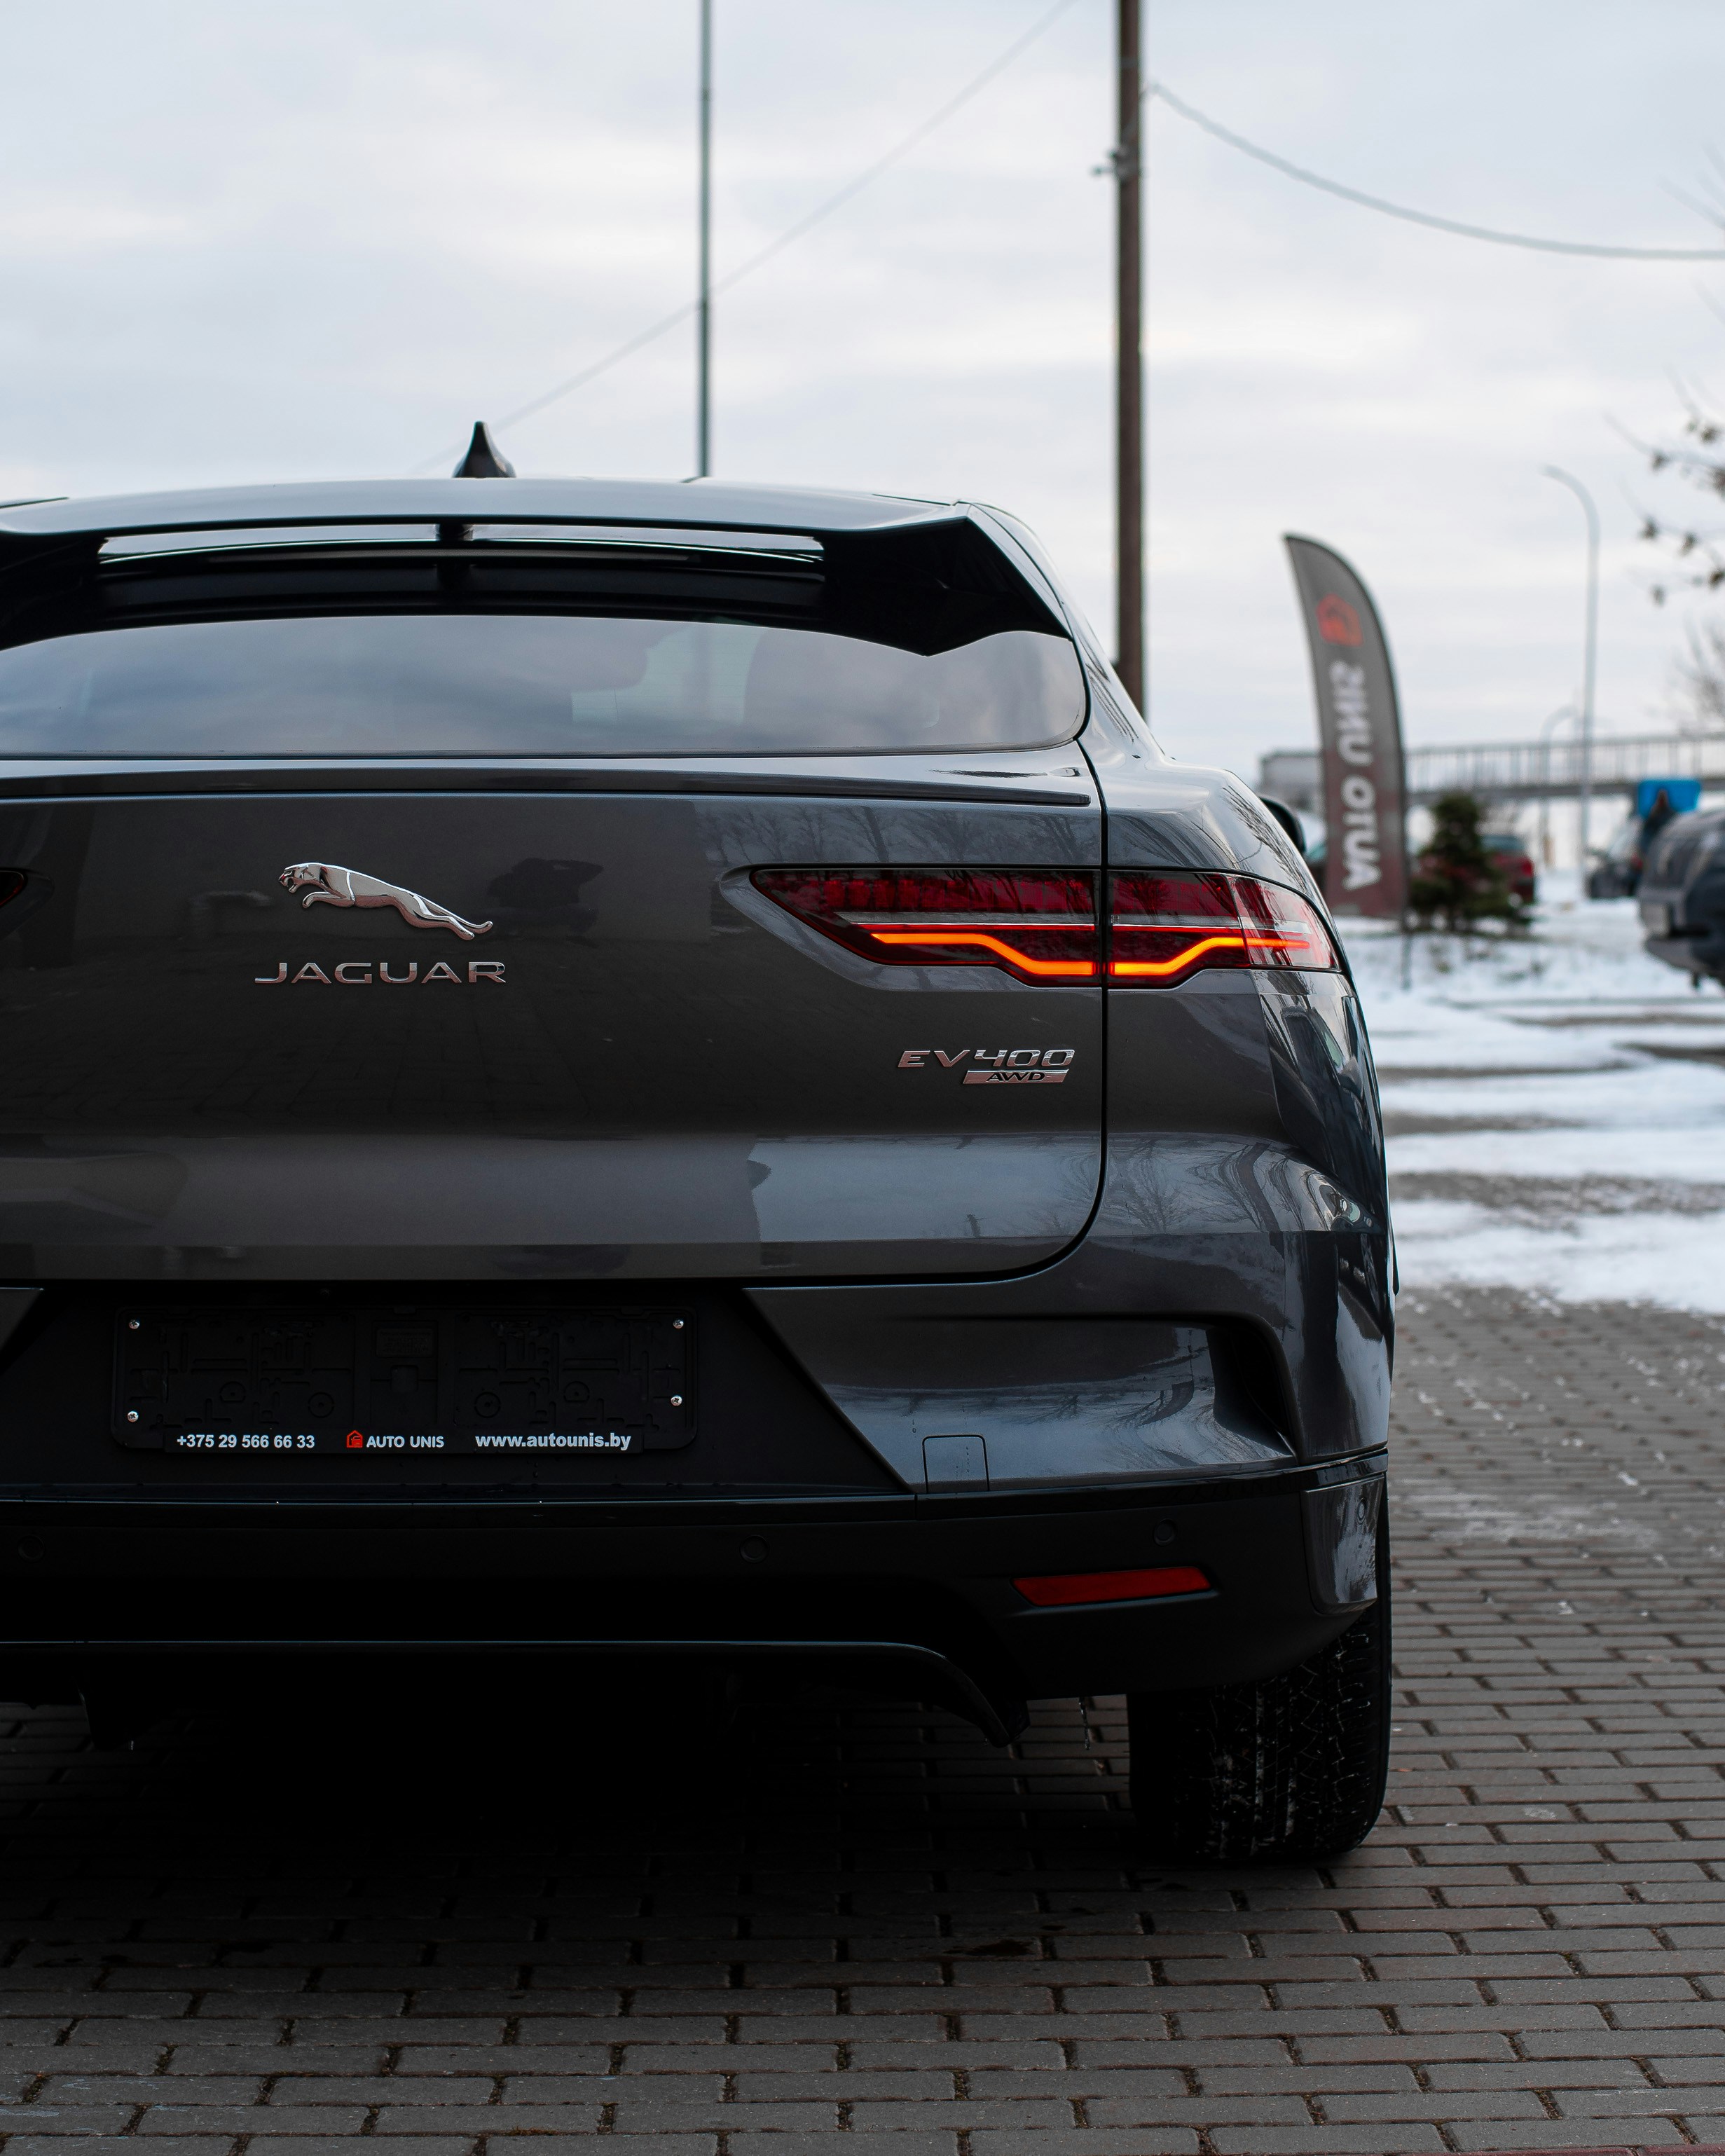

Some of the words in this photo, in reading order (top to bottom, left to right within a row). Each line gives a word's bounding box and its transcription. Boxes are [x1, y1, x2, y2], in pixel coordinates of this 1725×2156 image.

[254, 961, 507, 984] JAGUAR
[986, 1071, 1046, 1083] AWD
[177, 1434, 214, 1448] +375
[219, 1434, 237, 1448] 29
[242, 1434, 269, 1448] 566
[273, 1434, 292, 1448] 66
[296, 1434, 315, 1448] 33
[366, 1436, 405, 1448] AUTO
[410, 1436, 444, 1448] UNIS
[475, 1432, 631, 1451] www.autounis.by
